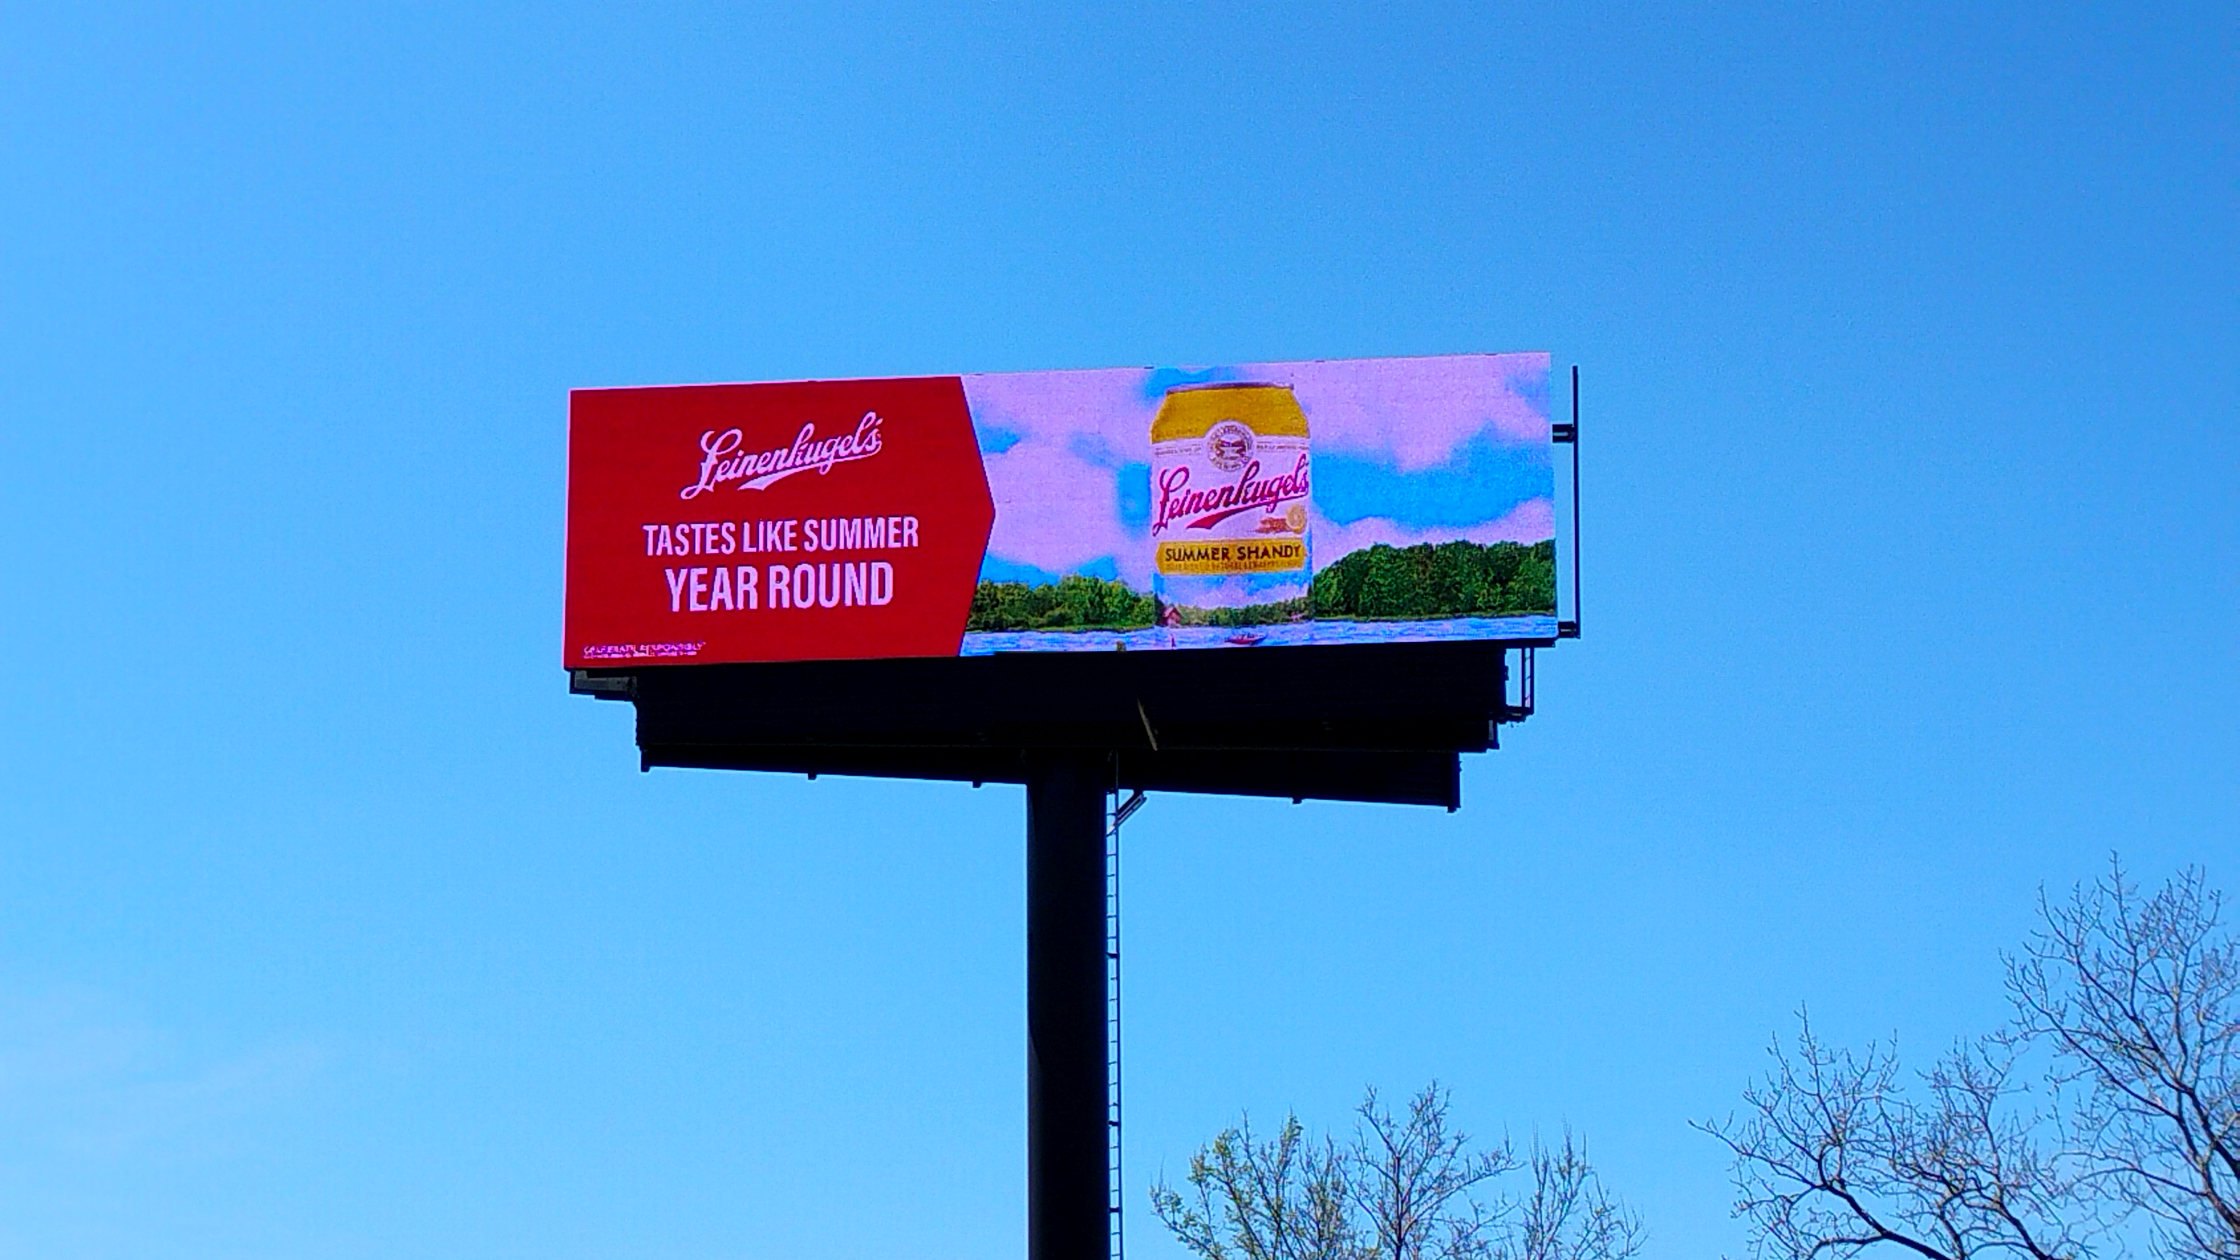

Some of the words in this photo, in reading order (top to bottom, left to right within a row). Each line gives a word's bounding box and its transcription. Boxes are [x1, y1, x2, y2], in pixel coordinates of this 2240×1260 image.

[680, 411, 882, 500] Leinenkugel's
[1152, 453, 1309, 537] Leinenkugel's
[643, 521, 736, 556] TASTES
[743, 518, 798, 553] LIKE
[804, 515, 919, 552] SUMMER
[1164, 547, 1231, 562] SUMMER
[1236, 544, 1301, 561] SHANDY
[665, 565, 758, 612] YEAR
[768, 561, 894, 609] ROUND
